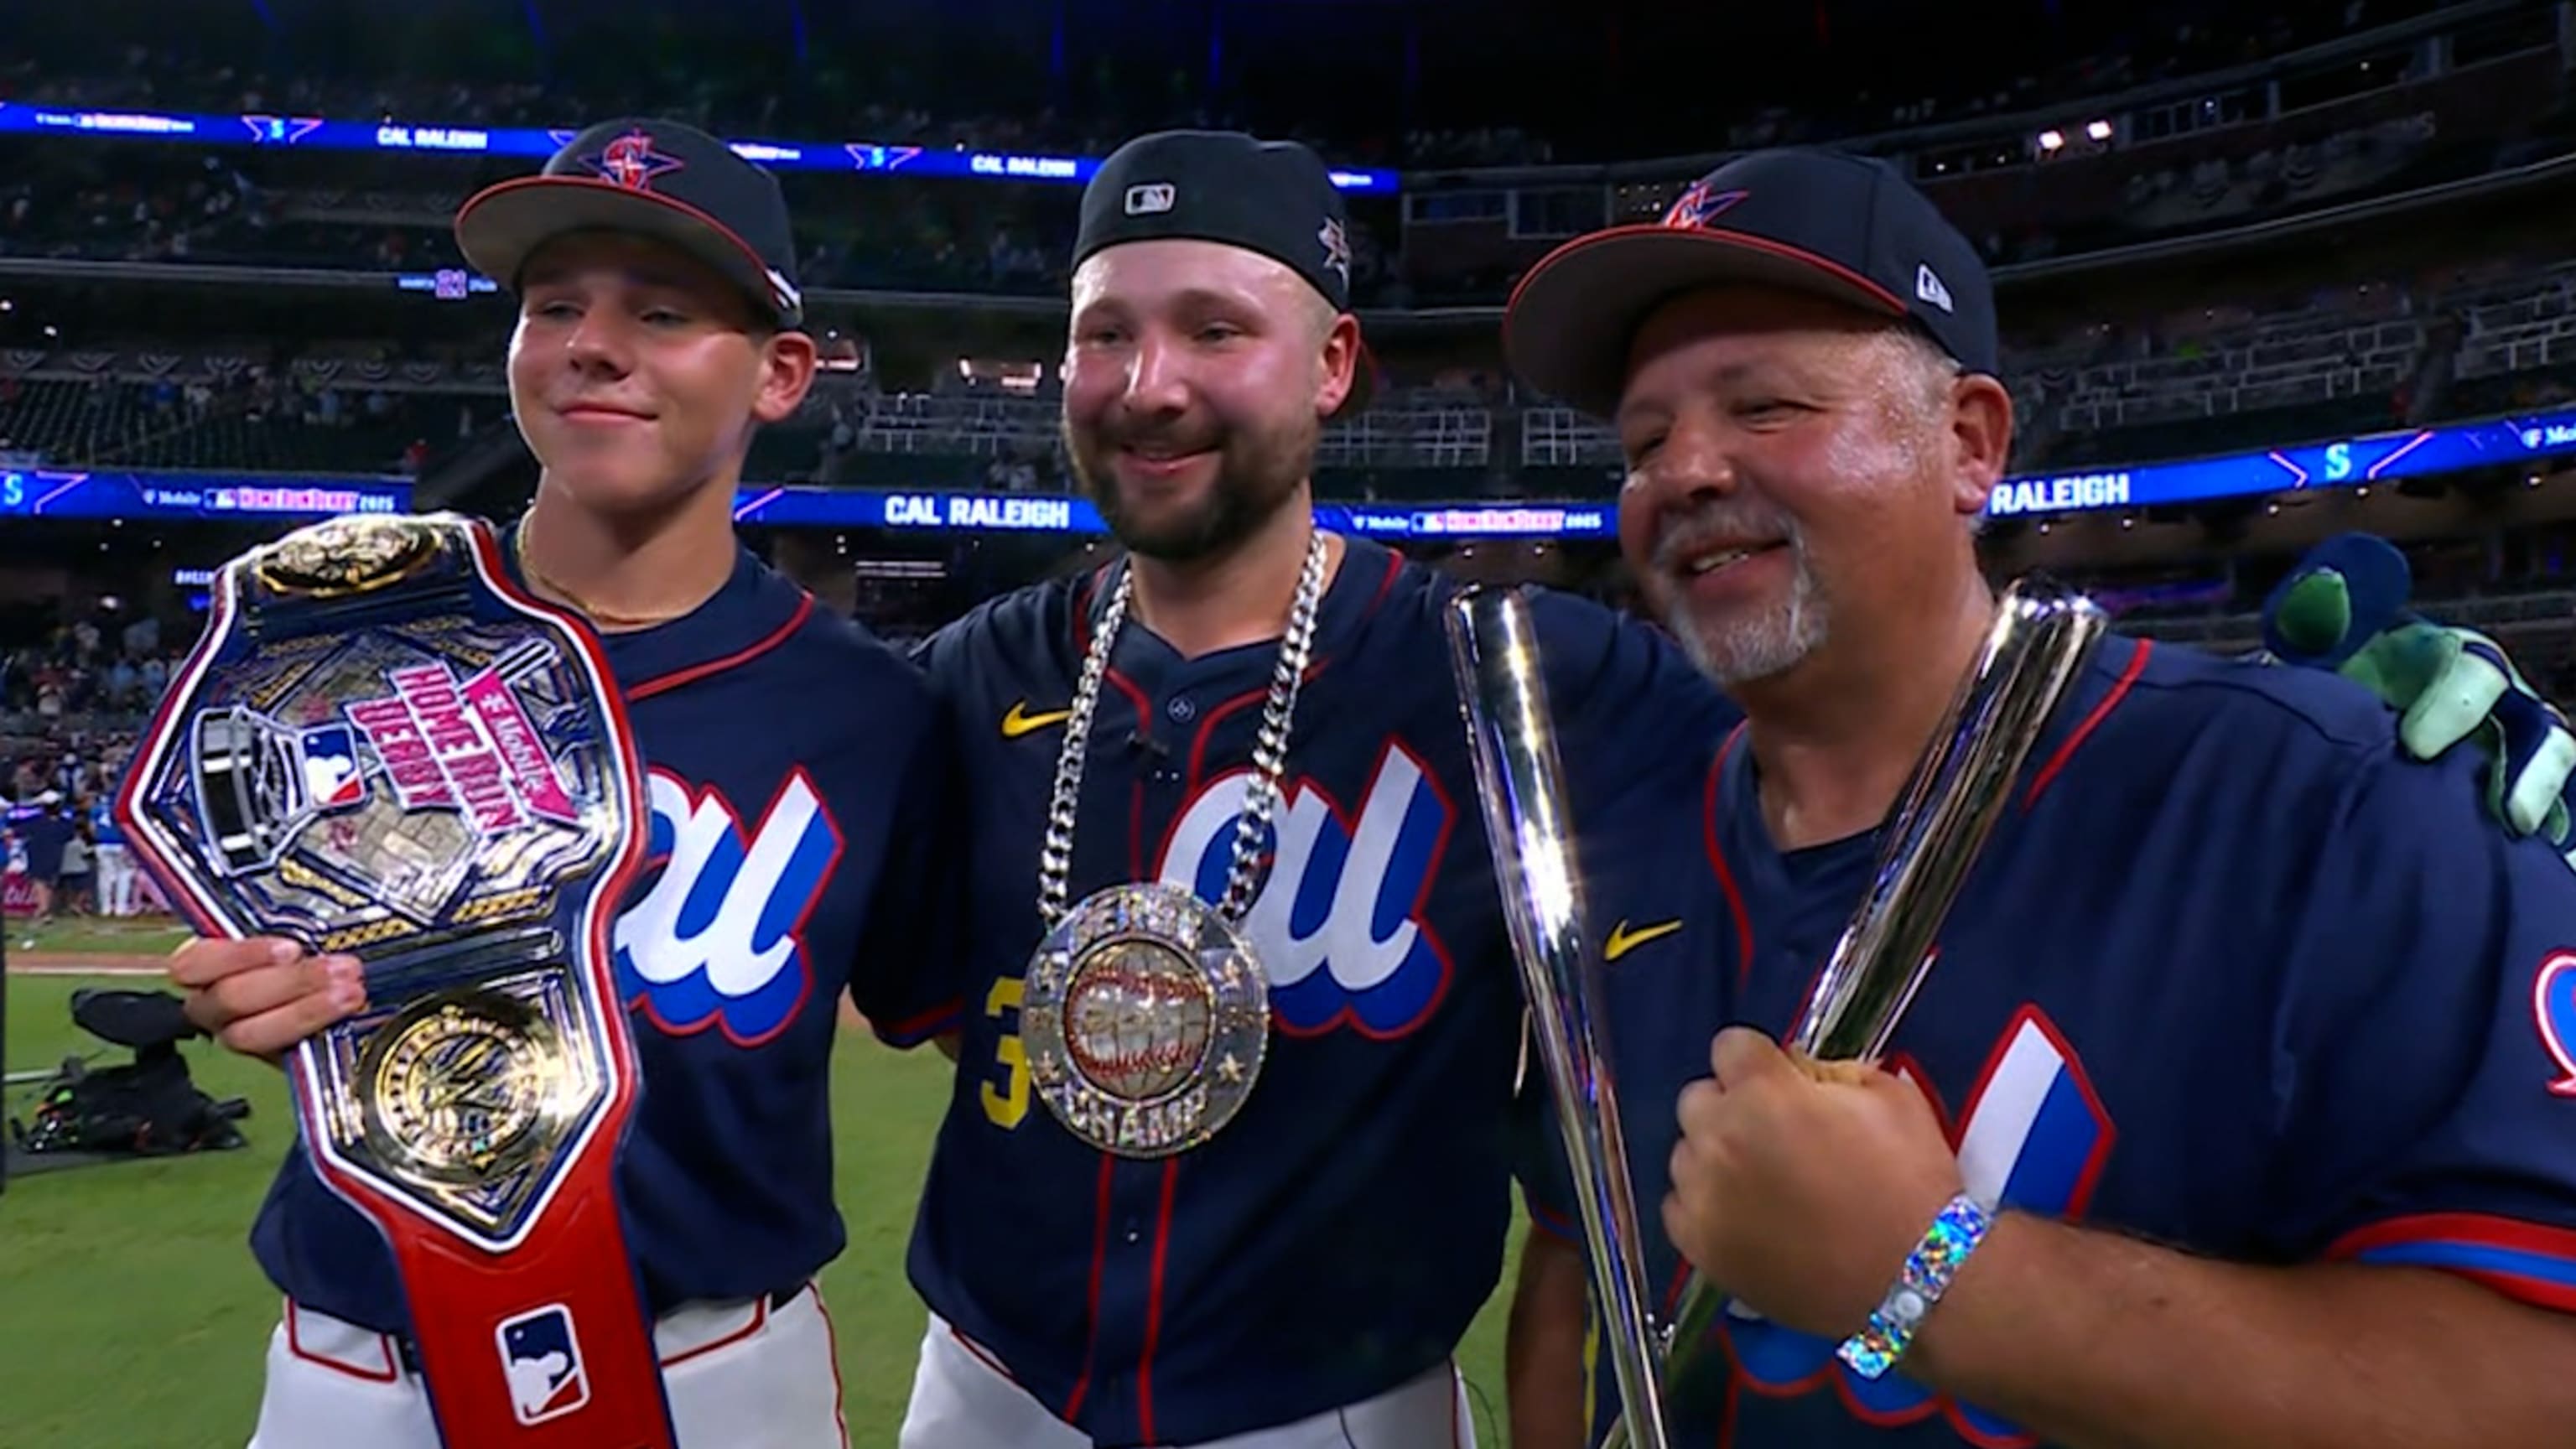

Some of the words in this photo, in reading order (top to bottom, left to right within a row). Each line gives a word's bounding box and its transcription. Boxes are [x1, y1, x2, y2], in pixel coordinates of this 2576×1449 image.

[2325, 444, 2352, 480] S
[4, 473, 23, 506] S
[1991, 473, 2131, 515] RALEIGH
[885, 495, 942, 526] CAL
[948, 497, 1070, 529] RALEIGH
[348, 698, 455, 805] DERBY
[392, 662, 486, 756] HOME
[442, 751, 525, 833] RUN
